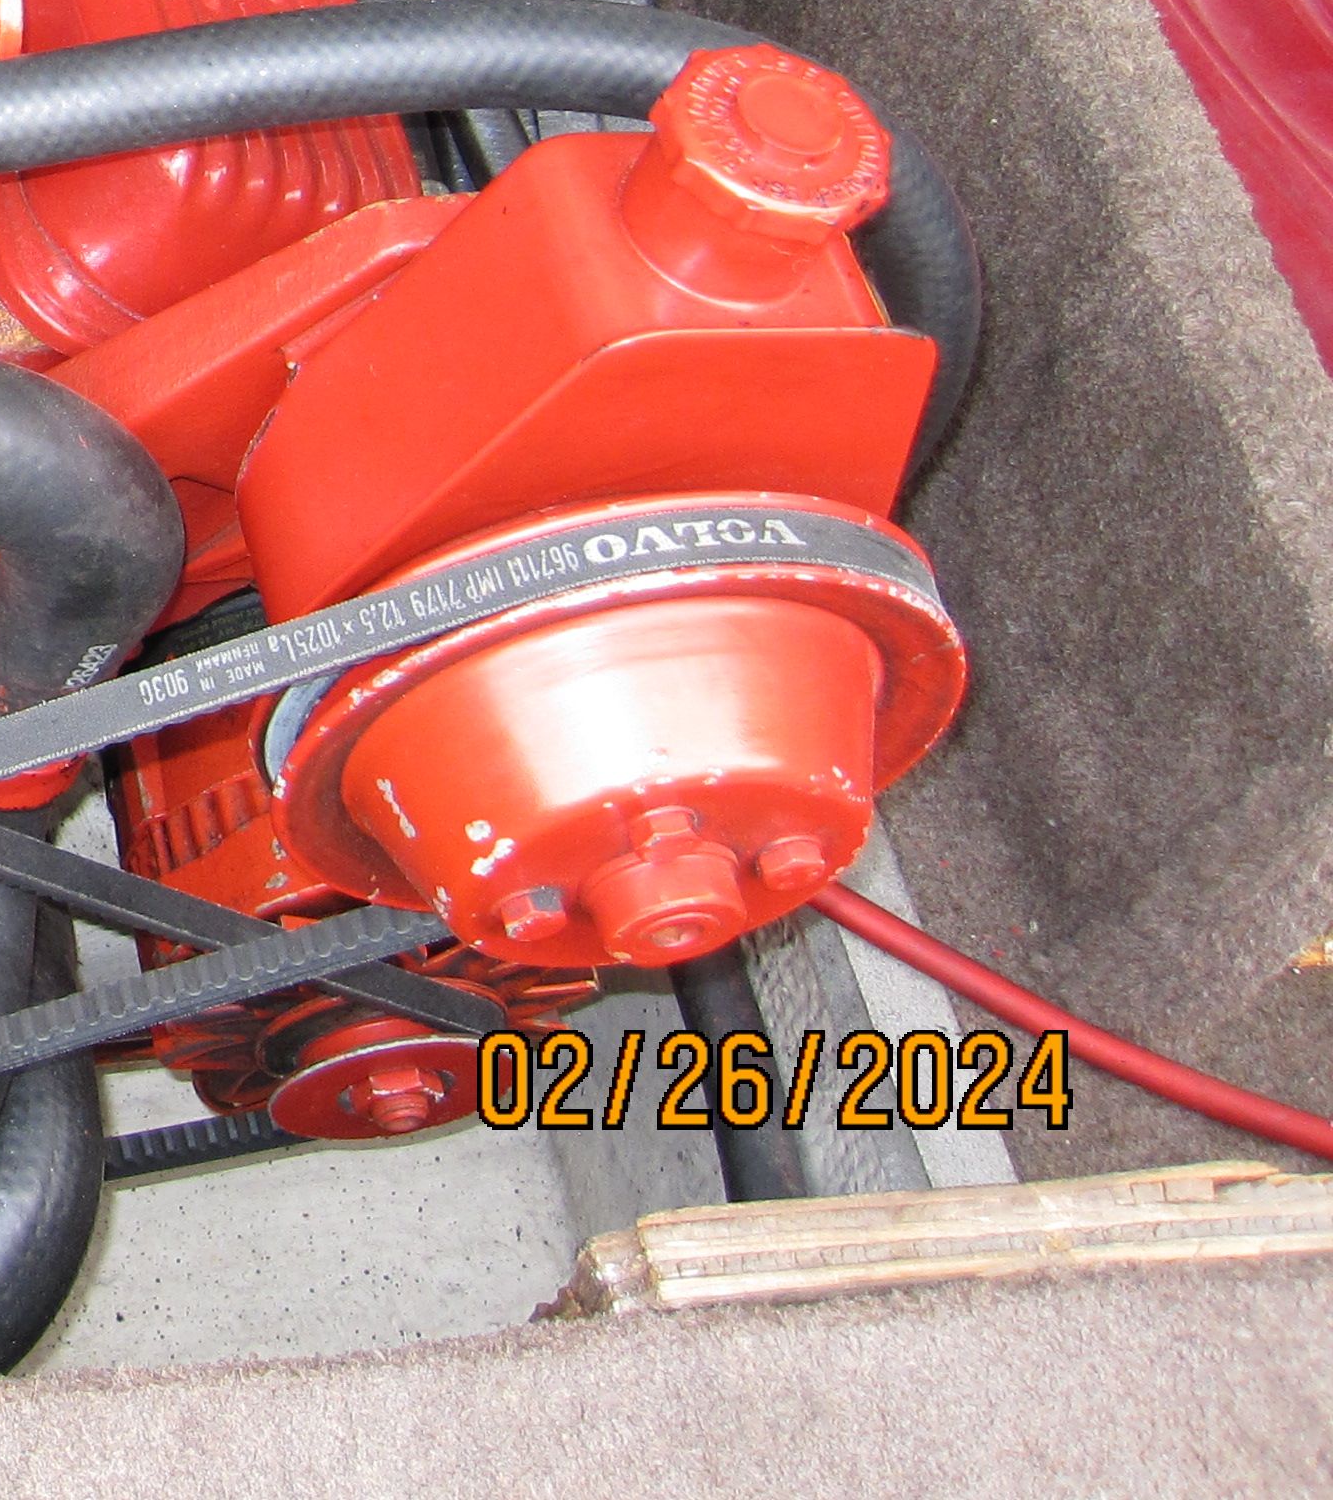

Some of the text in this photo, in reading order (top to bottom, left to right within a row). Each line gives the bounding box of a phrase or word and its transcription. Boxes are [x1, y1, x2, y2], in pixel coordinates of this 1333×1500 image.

[582, 518, 808, 564] VOLVO
[465, 565, 505, 604] IMP
[199, 660, 266, 693] MADE IN
